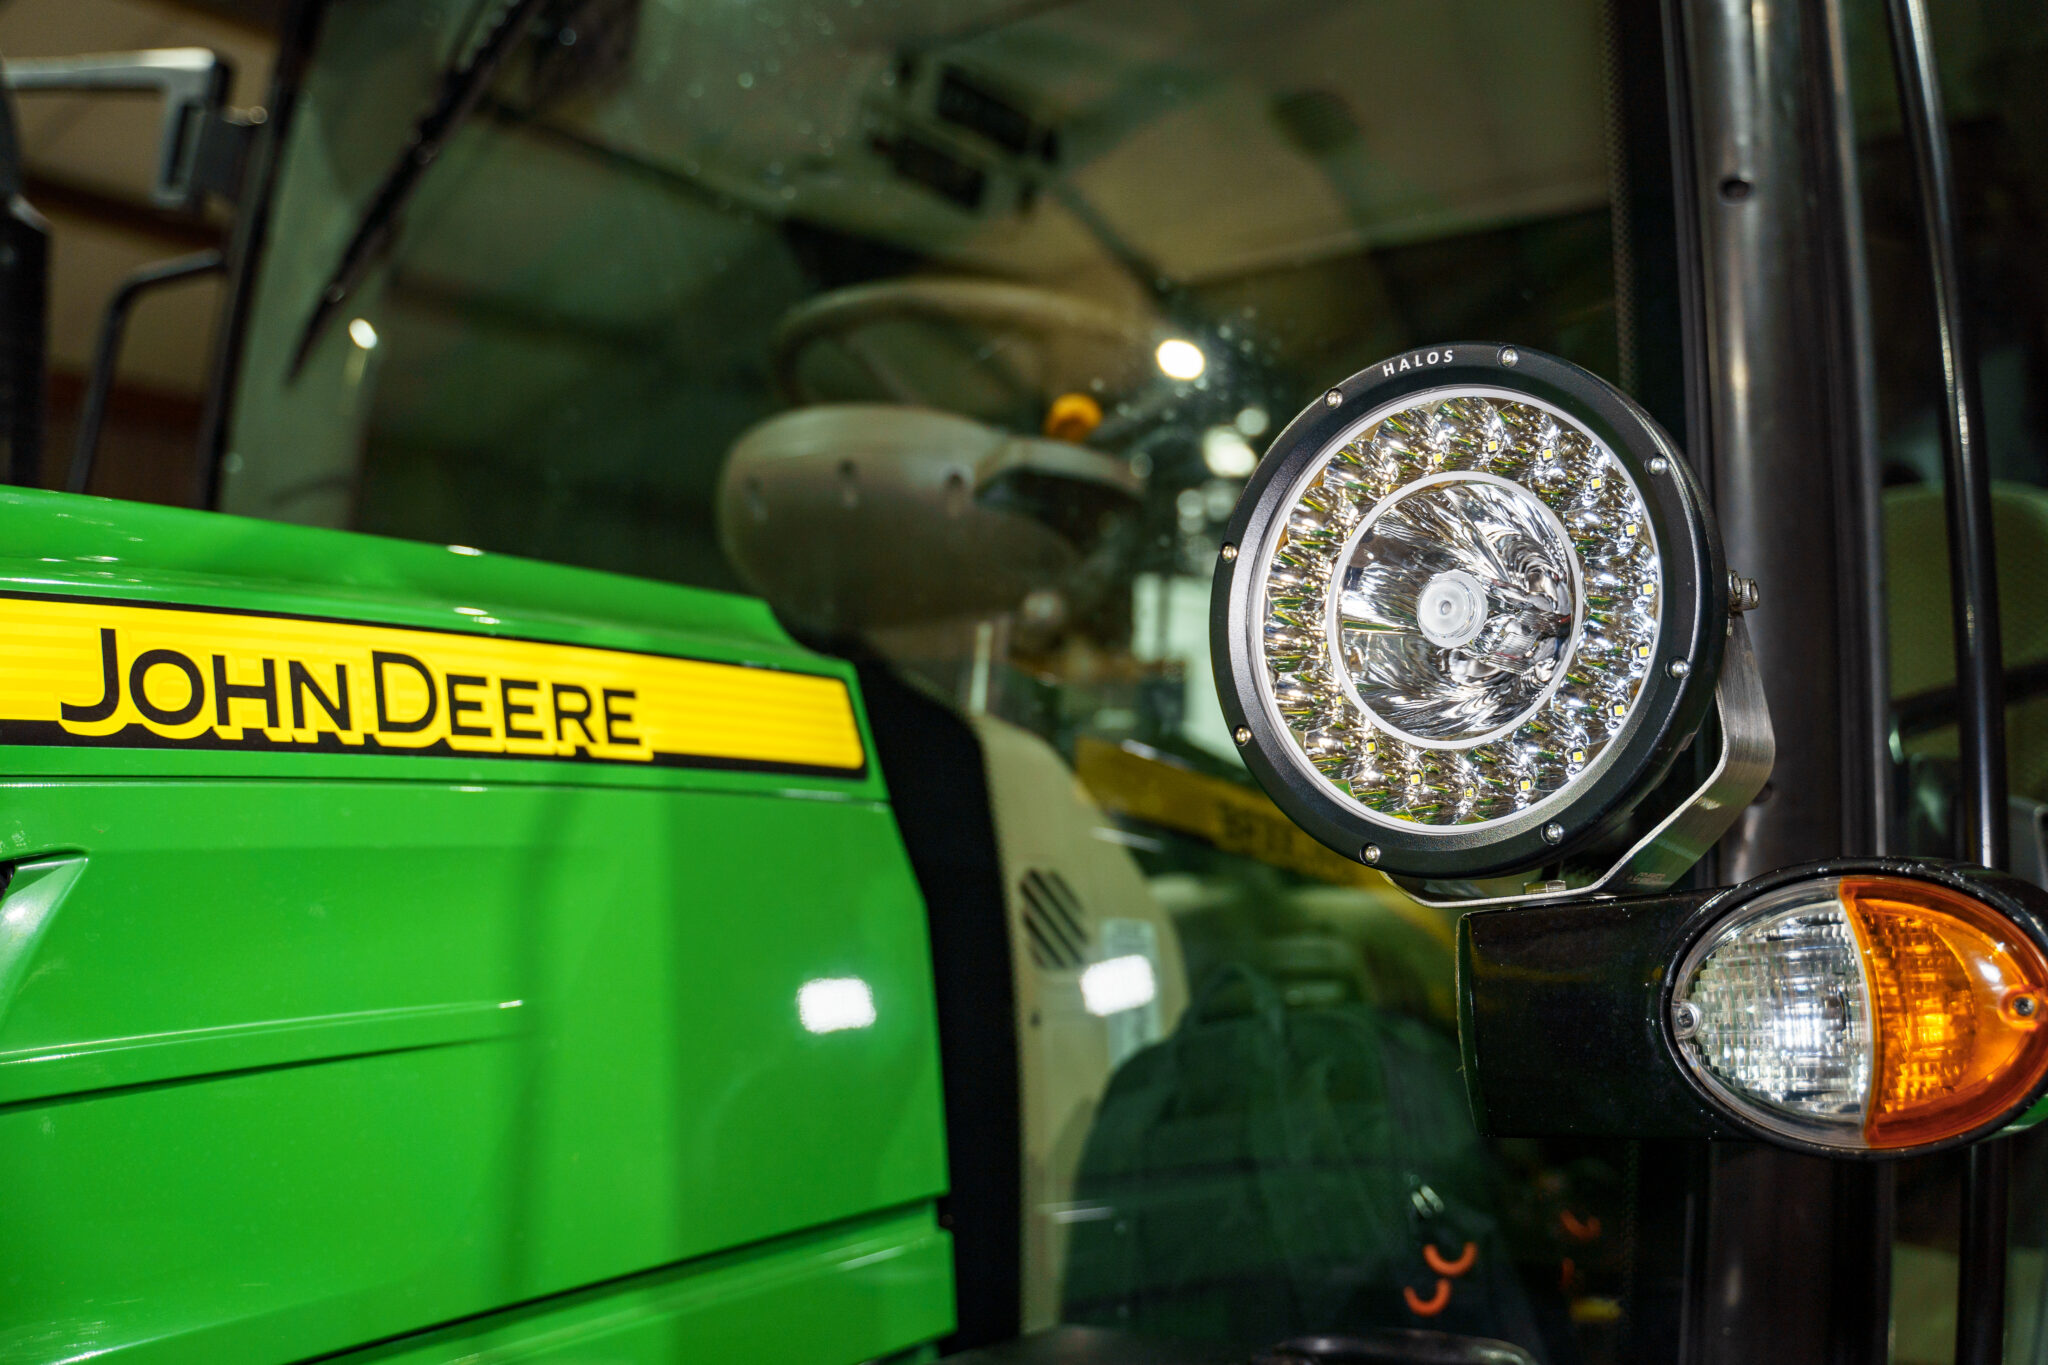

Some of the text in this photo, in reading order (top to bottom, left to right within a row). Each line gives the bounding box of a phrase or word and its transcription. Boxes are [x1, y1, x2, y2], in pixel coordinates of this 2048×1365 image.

[1382, 350, 1454, 377] HALOS
[60, 628, 641, 746] JOHN DEERE
